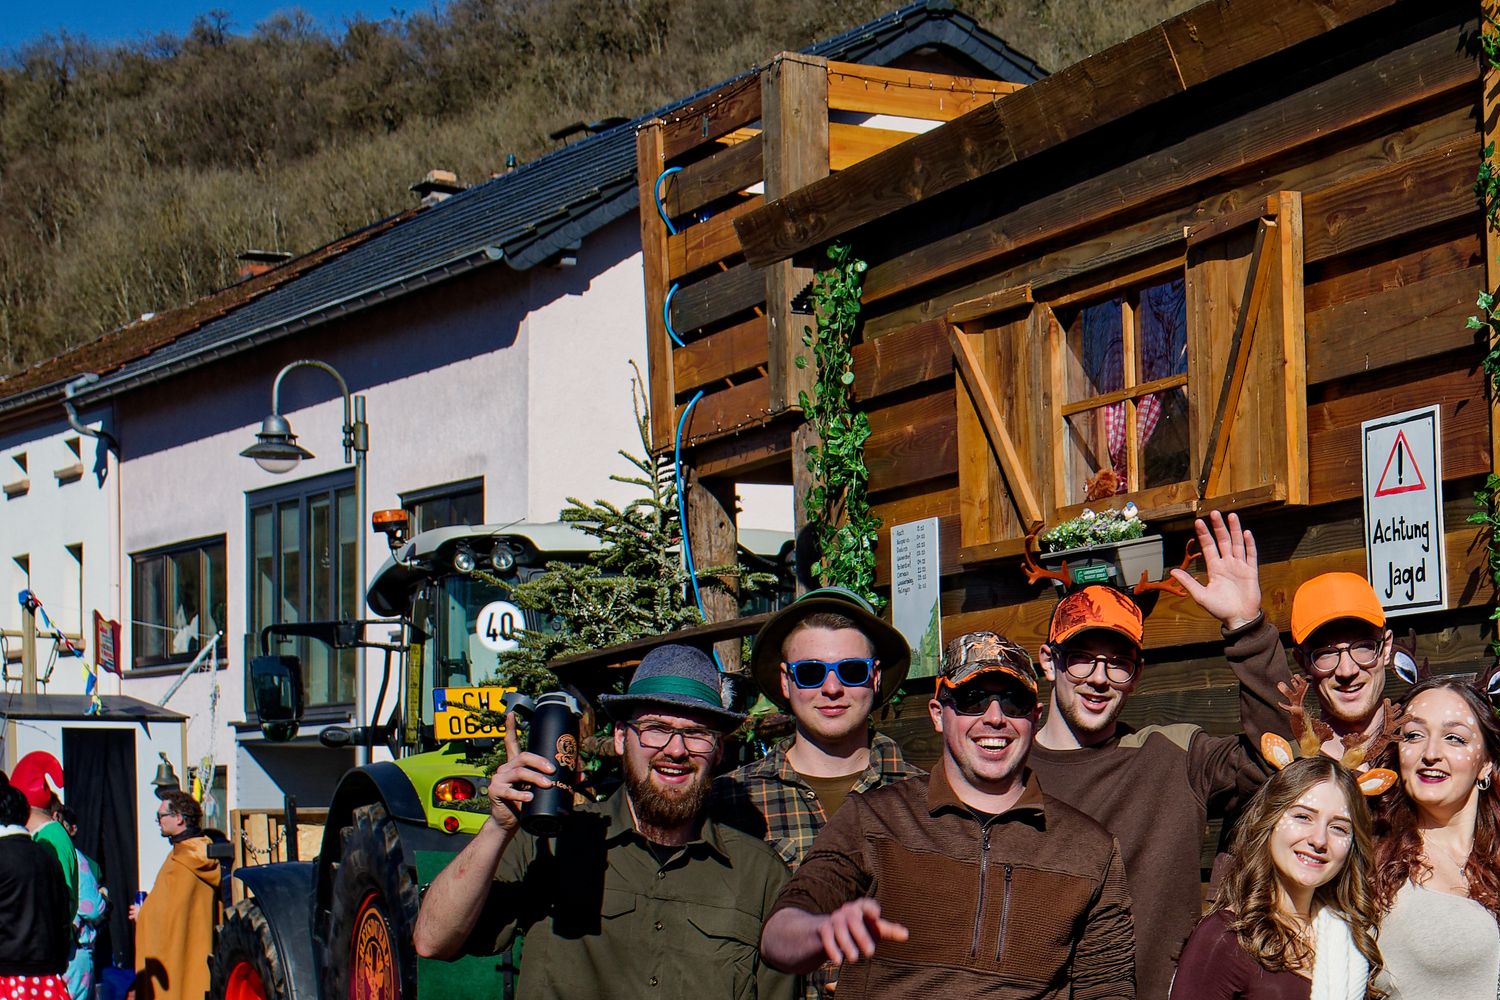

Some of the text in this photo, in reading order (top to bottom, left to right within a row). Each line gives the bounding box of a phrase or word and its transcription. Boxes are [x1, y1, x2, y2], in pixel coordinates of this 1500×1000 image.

[1373, 515, 1430, 552] Achtung
[1385, 557, 1426, 601] Jagd
[486, 612, 514, 641] 40
